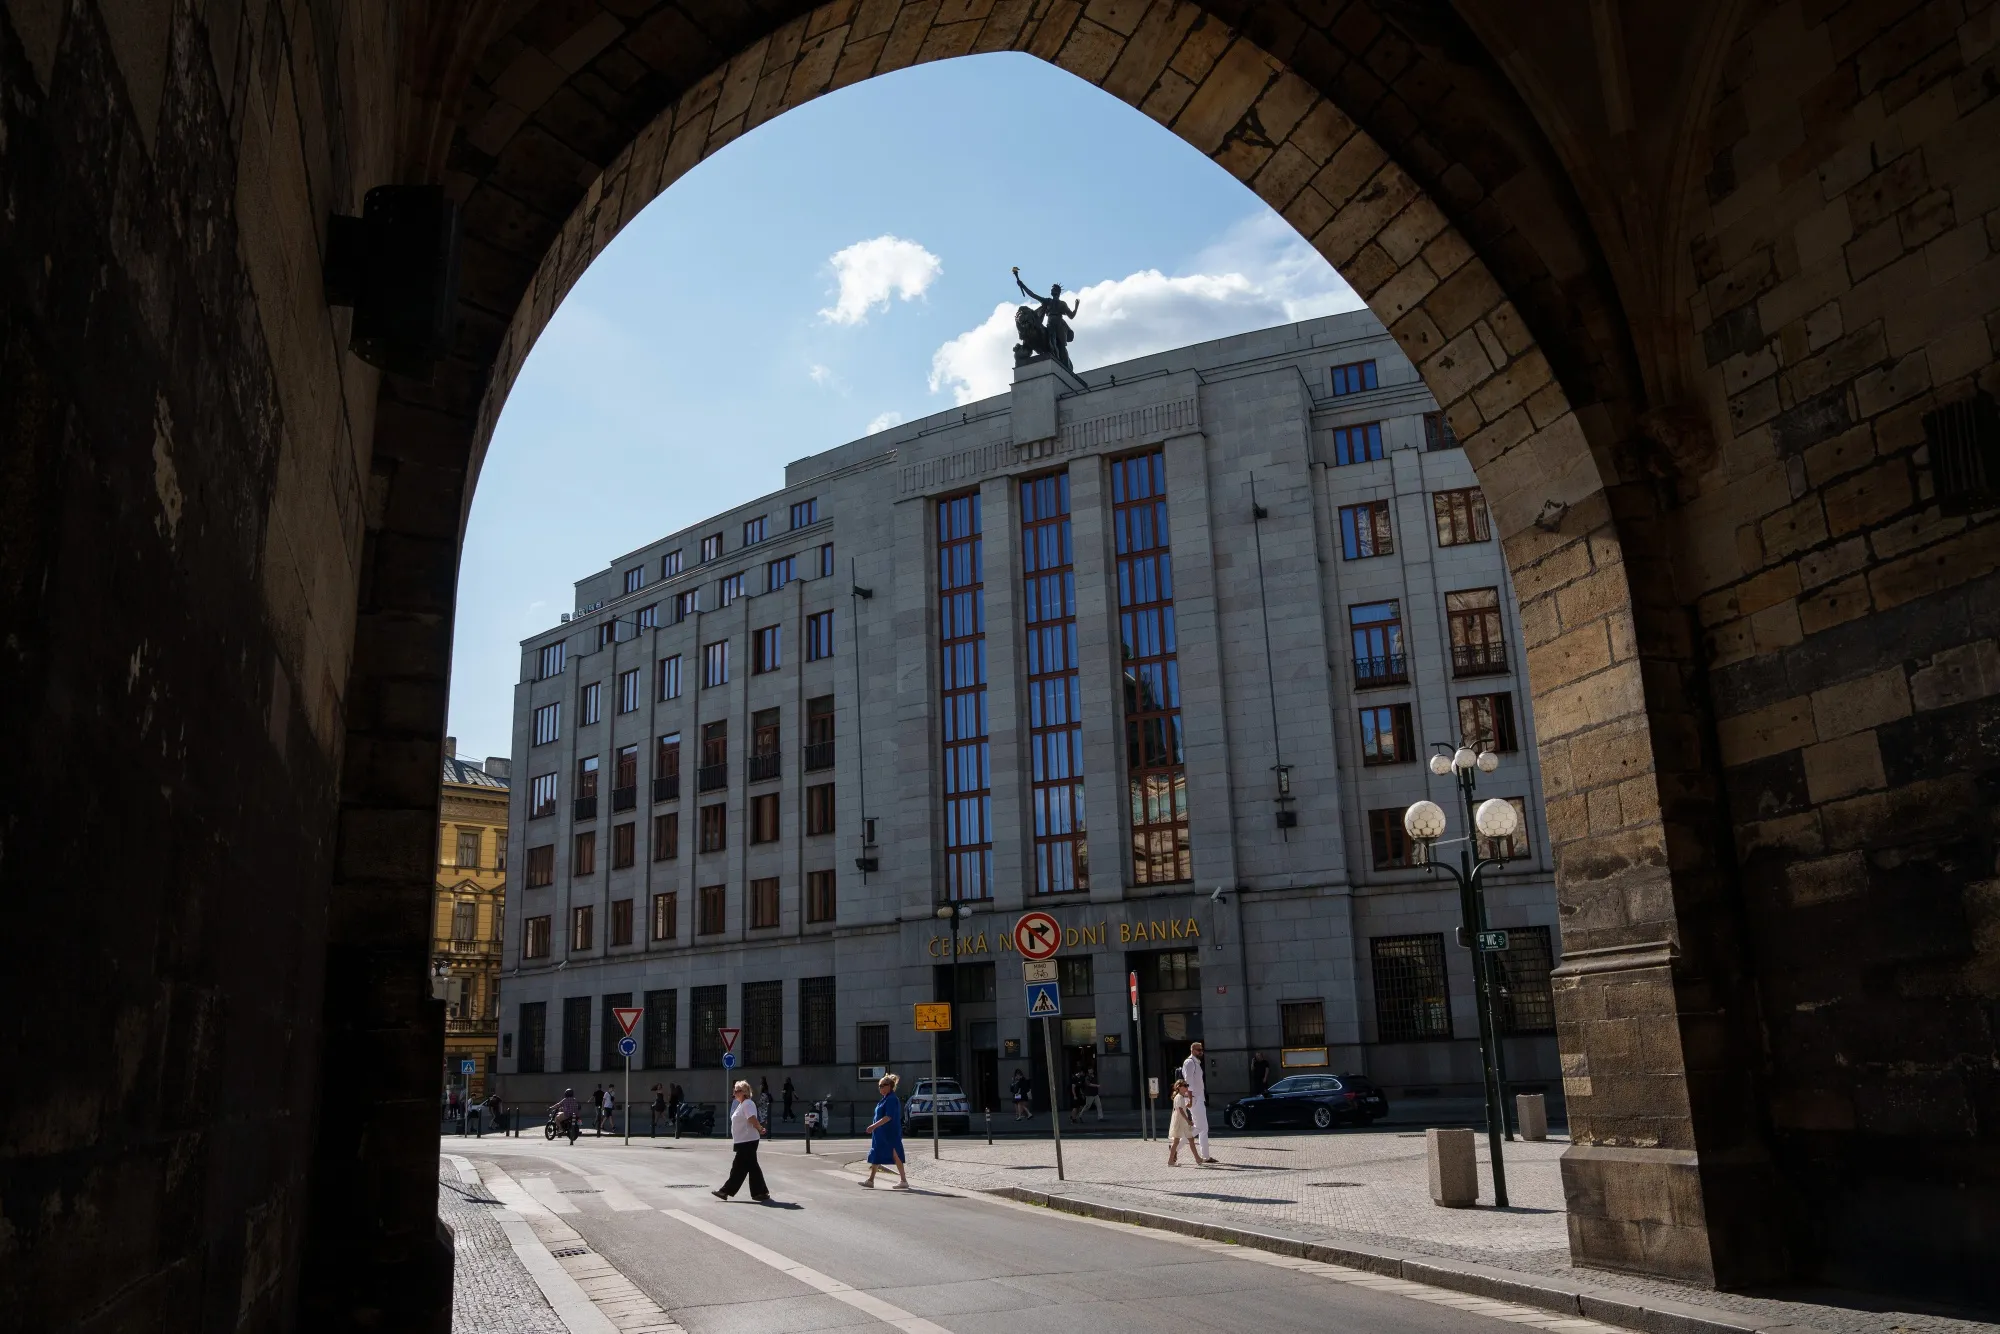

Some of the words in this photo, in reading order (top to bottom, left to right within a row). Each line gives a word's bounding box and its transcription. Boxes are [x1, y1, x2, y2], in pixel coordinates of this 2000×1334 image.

[999, 921, 1106, 953] NDNÍ
[1120, 918, 1200, 943] BANKA
[1486, 934, 1497, 946] WC
